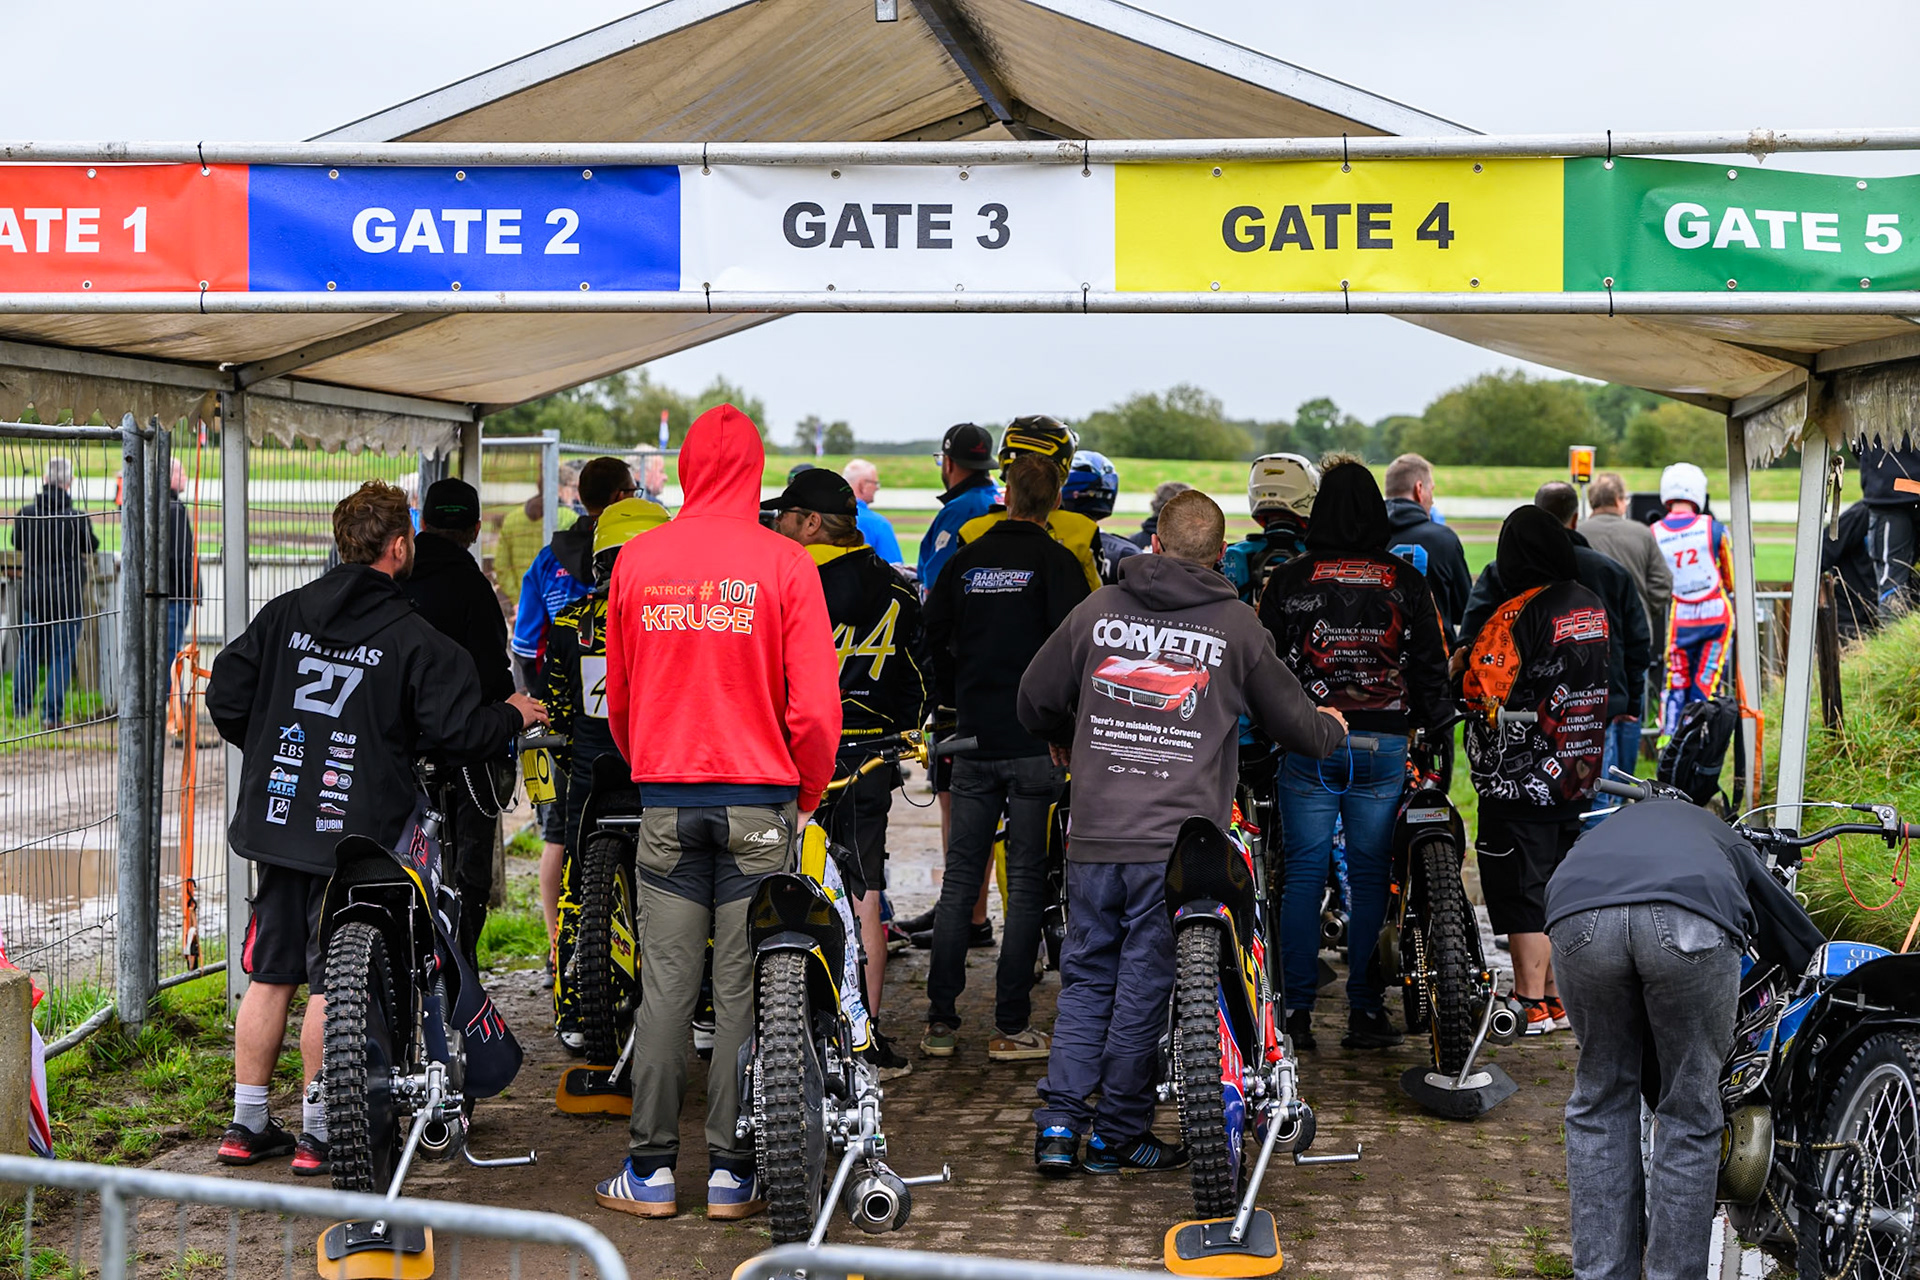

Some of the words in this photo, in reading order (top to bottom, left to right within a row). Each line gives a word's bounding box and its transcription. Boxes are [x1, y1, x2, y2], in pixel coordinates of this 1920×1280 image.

[123, 206, 147, 252] 1
[352, 207, 522, 254] GATE
[544, 208, 580, 254] 2
[783, 201, 952, 249] GATE
[976, 202, 1010, 249] 3
[1222, 203, 1393, 252] GATE
[1416, 202, 1454, 249] 4
[1664, 202, 1841, 252] GATE
[1864, 214, 1902, 254] 5
[1674, 548, 1698, 569] 72
[973, 571, 1031, 581] BAANSPORT
[644, 585, 695, 597] PATRICK
[642, 604, 754, 635] KRUSE
[1124, 614, 1173, 626] CORVETTE
[1178, 621, 1227, 636] STINGRAY
[1092, 618, 1227, 668] CORVETTE
[293, 656, 364, 718] 27
[330, 731, 357, 745] ISAB
[1090, 714, 1114, 726] There's
[1115, 720, 1125, 728] no
[1125, 721, 1161, 734] mistaking
[1169, 726, 1202, 739] Corvette
[1093, 727, 1104, 736] for
[1104, 729, 1137, 742] anything
[1138, 733, 1152, 742] but
[1158, 736, 1194, 749] Corvette.
[279, 743, 304, 758] EBS
[268, 779, 297, 793] MTR
[319, 789, 349, 801] MOTUL
